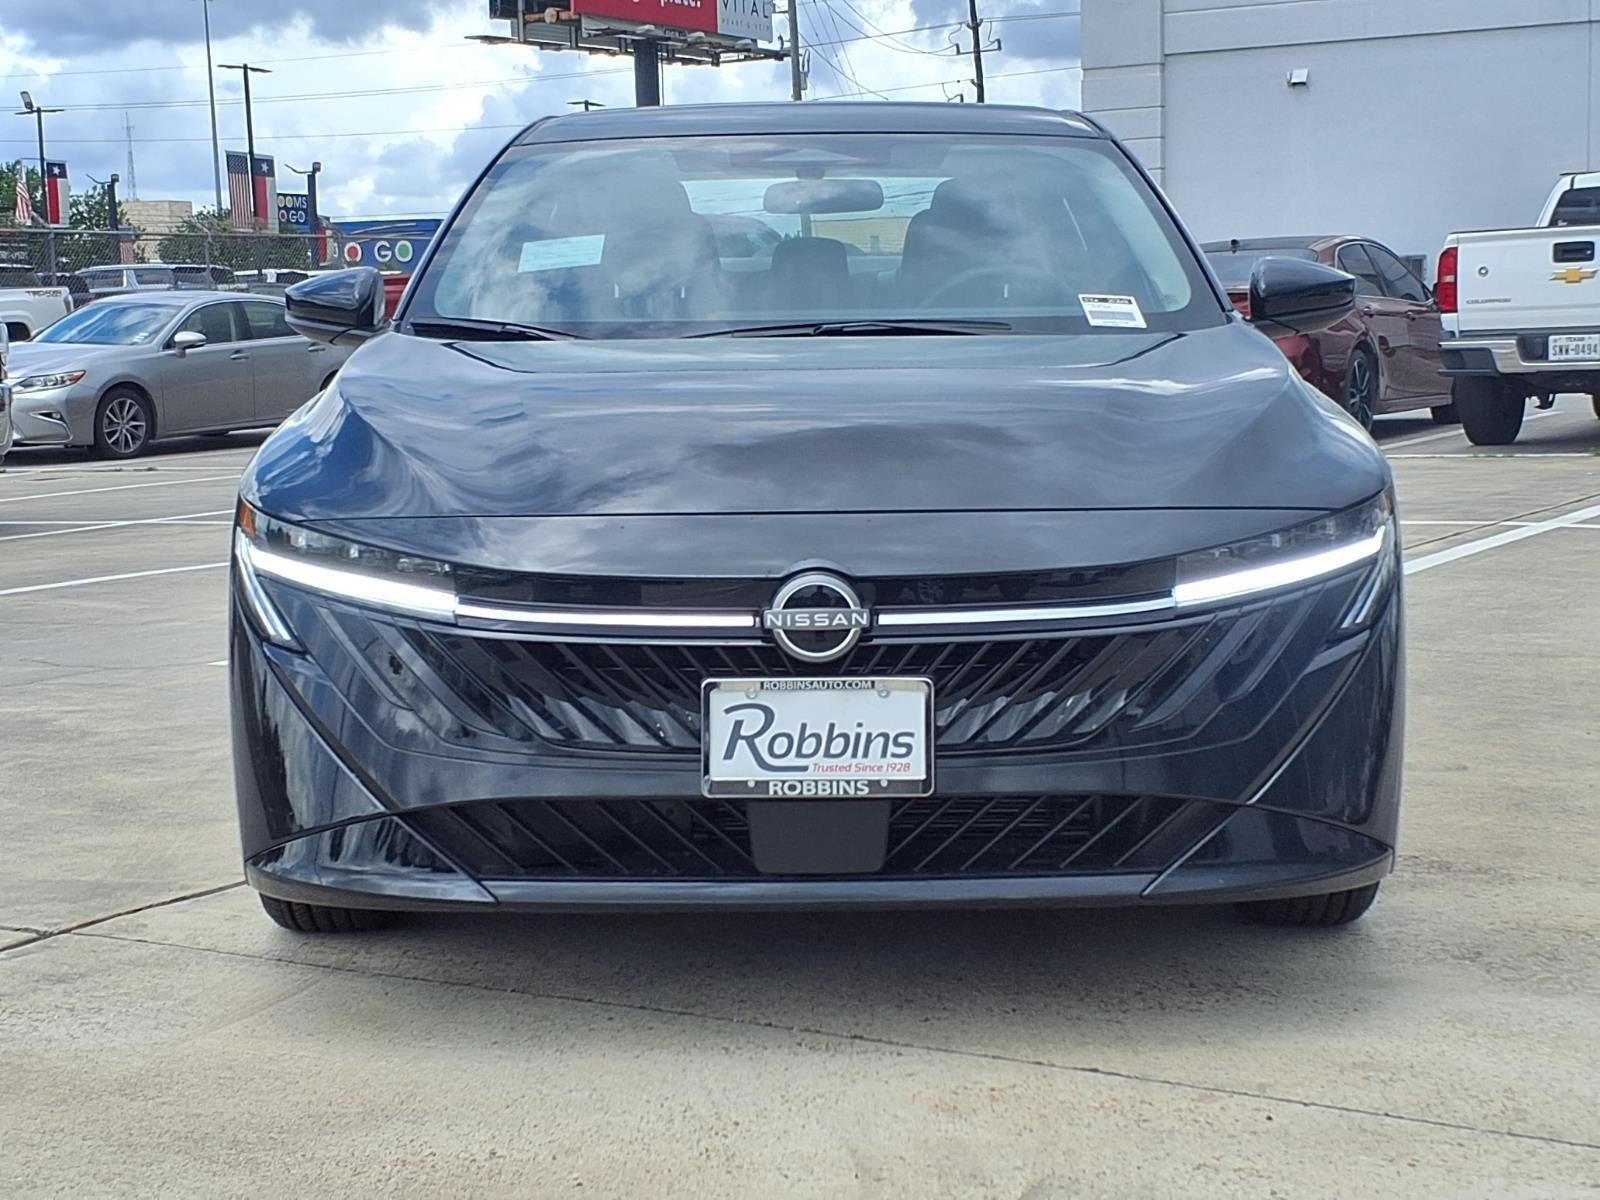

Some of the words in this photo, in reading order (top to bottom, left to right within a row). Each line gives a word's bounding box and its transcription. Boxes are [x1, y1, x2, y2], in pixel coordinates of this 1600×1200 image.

[722, 0, 769, 19] VITAL
[278, 195, 307, 209] OOMS
[279, 209, 288, 222] O
[289, 210, 306, 223] GO
[374, 240, 413, 263] GO
[766, 612, 868, 628] NISSAN
[763, 680, 873, 691] ROBBINSAUTO.COM
[722, 702, 915, 773] Robbins
[812, 762, 852, 773] Trusted
[854, 762, 884, 773] Since
[886, 762, 911, 773] 1928
[768, 780, 870, 796] ROBBINS
